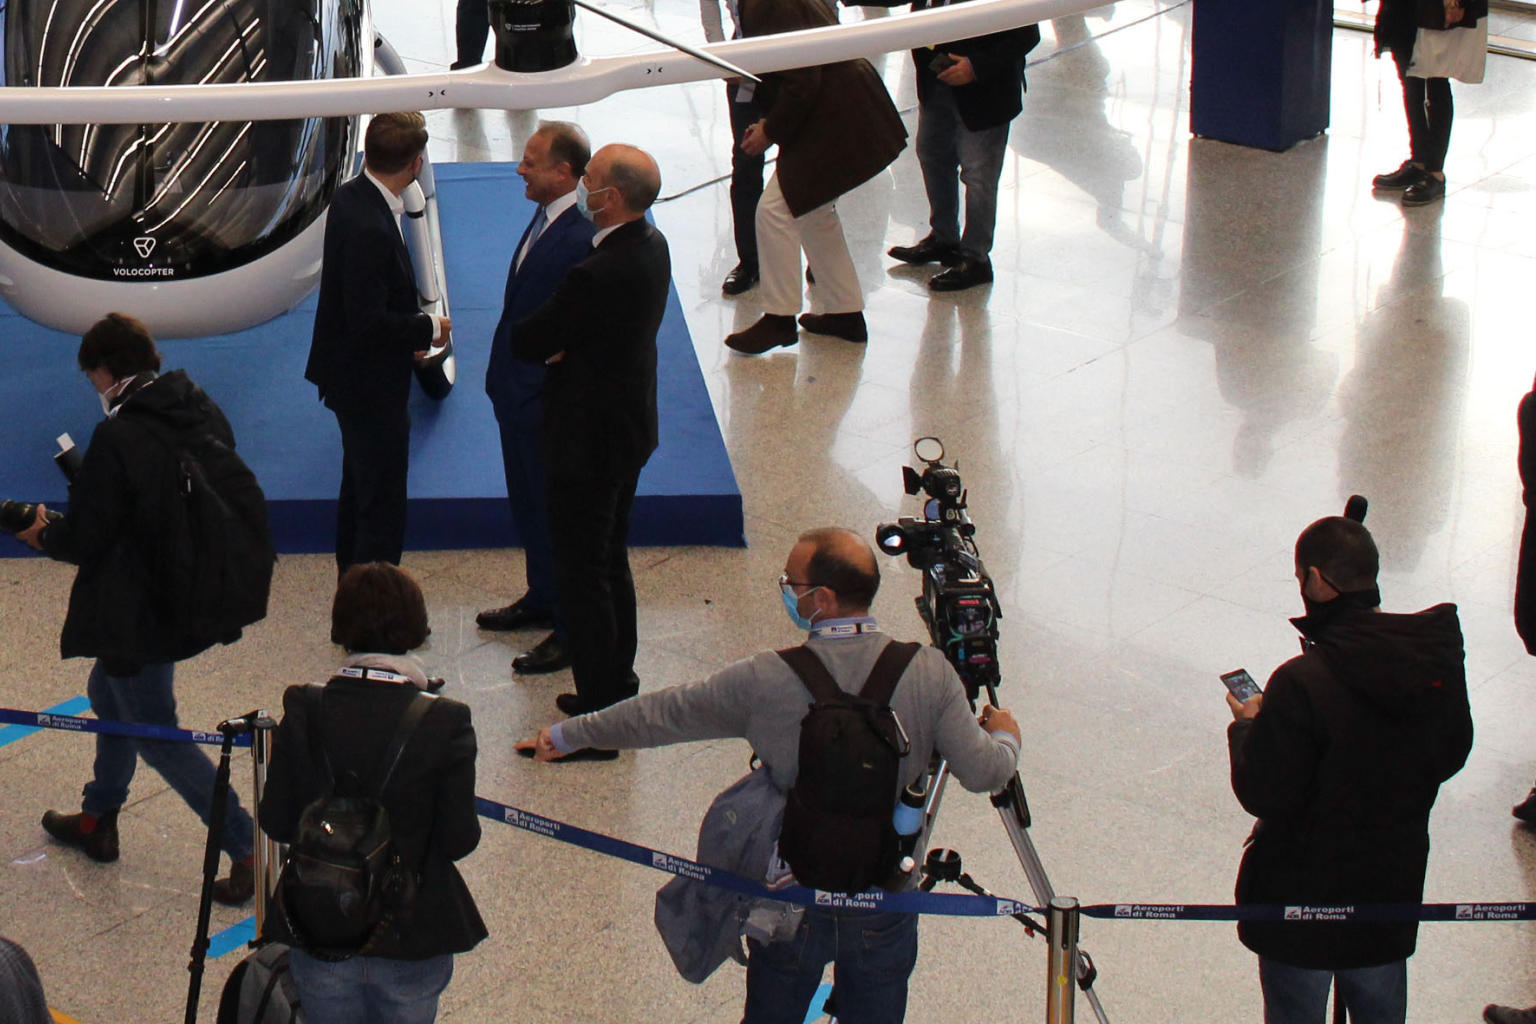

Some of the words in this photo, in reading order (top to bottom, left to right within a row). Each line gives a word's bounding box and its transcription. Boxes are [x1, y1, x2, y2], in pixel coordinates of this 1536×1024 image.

[113, 268, 174, 276] VOLOCOPTER
[519, 811, 560, 830] Aeroporti
[529, 822, 554, 836] Roma
[668, 856, 711, 875] Aeroporti
[679, 866, 705, 880] Roma
[833, 898, 843, 906] di
[846, 899, 876, 908] Roma
[1474, 904, 1525, 912] Aeroporti
